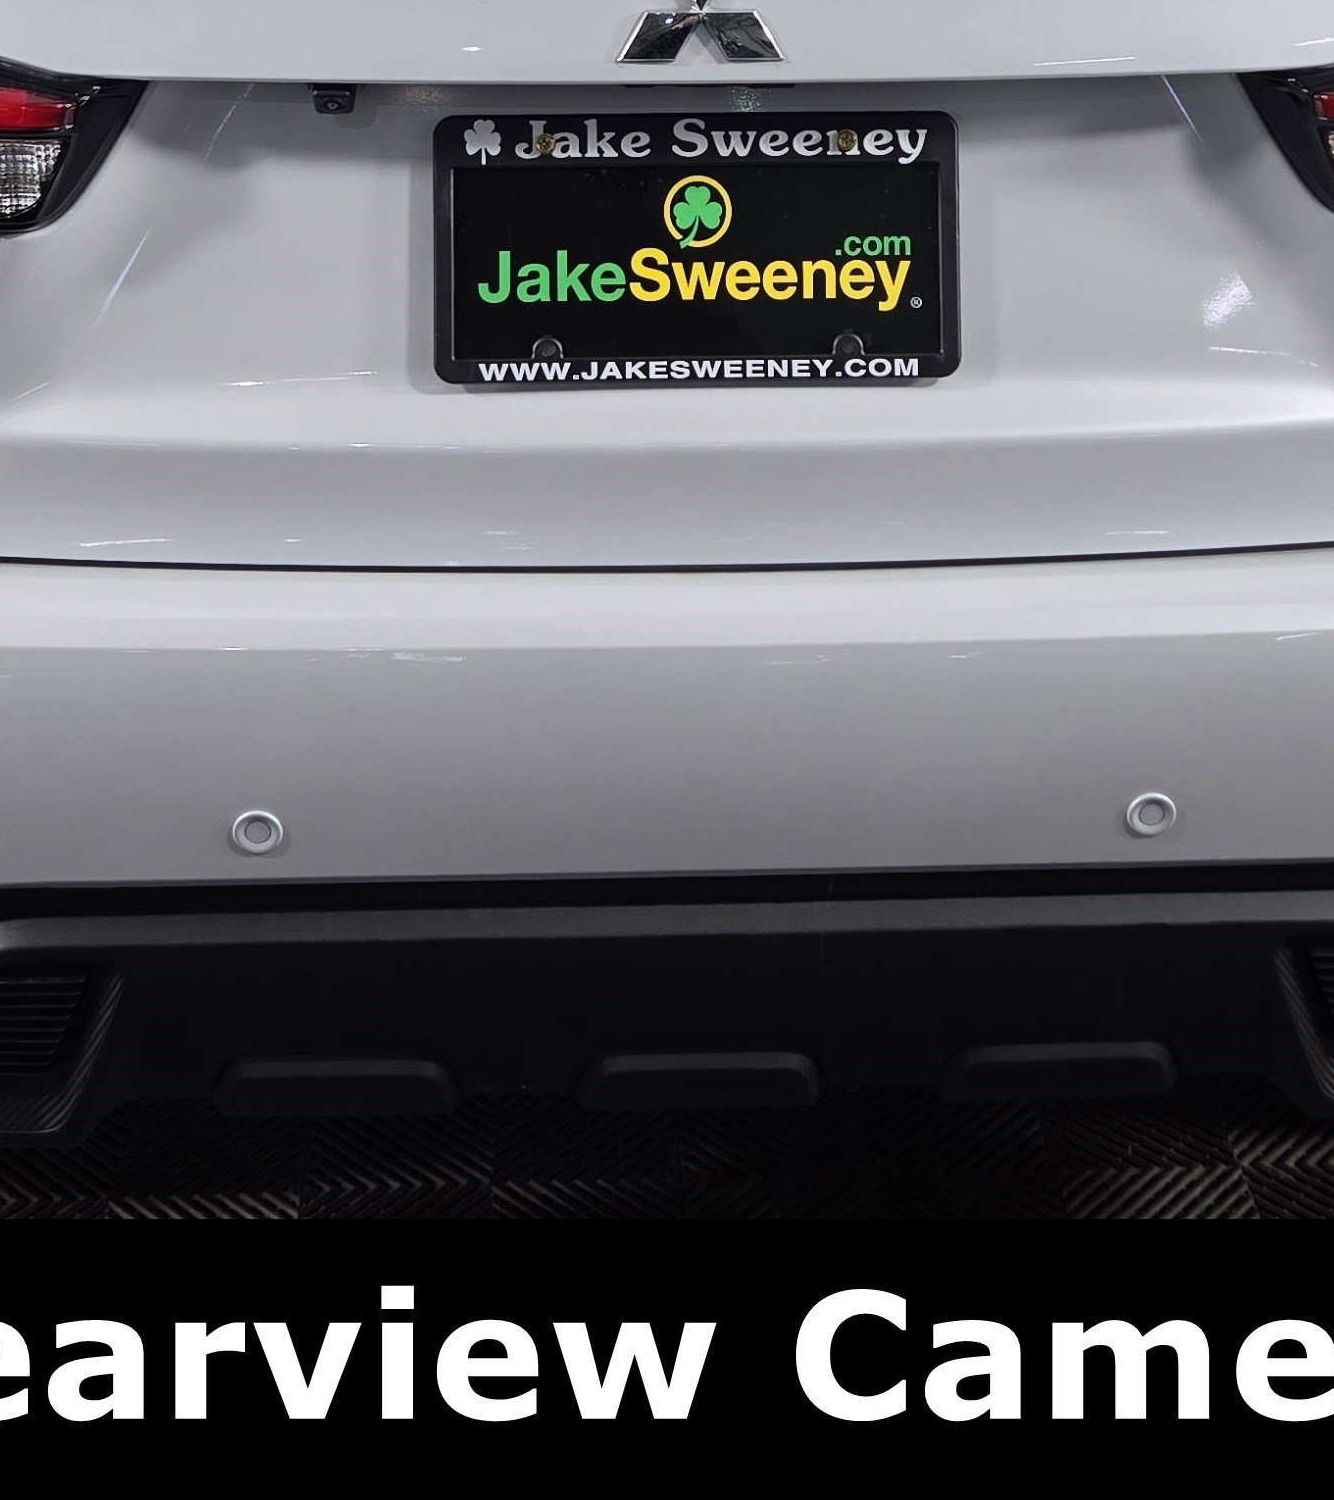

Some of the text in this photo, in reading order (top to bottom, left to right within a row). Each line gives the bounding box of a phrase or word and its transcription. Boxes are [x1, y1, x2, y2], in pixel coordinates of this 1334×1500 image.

[514, 118, 927, 164] Jake Sweeney
[478, 358, 919, 382] WWW.JAKESWEENEY.COM
